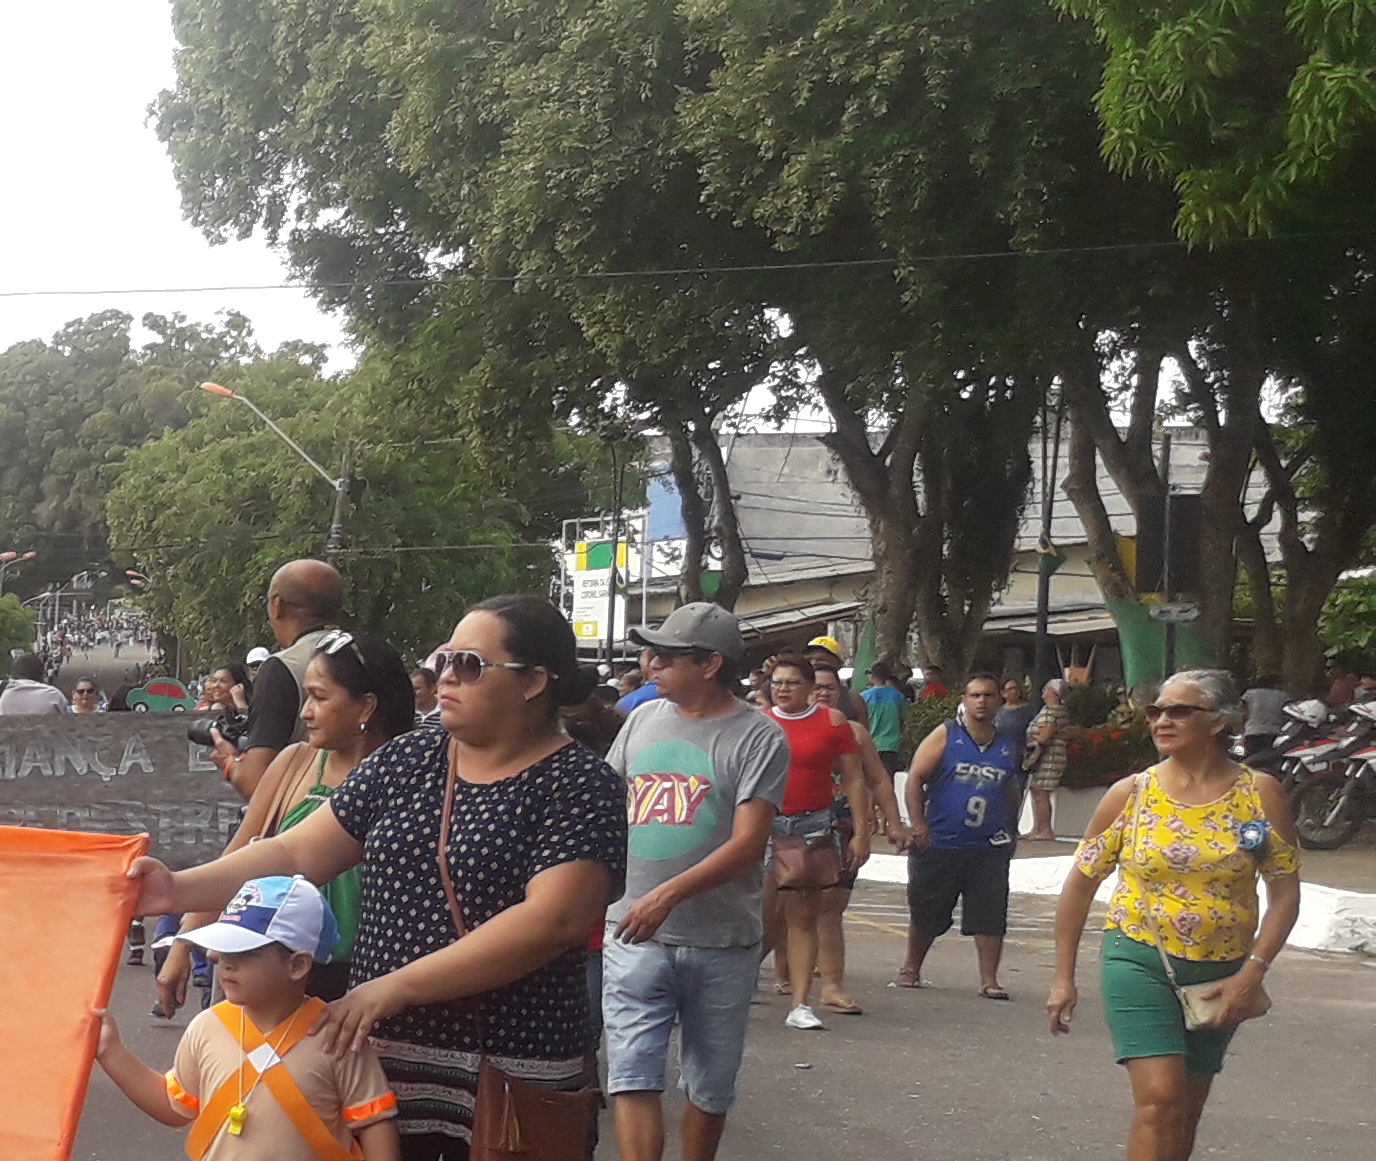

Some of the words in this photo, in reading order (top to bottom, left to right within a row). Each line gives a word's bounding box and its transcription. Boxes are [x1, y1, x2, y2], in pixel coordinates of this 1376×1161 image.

[955, 762, 1008, 782] EAST
[627, 772, 712, 827] YAY
[964, 796, 988, 828] 9
